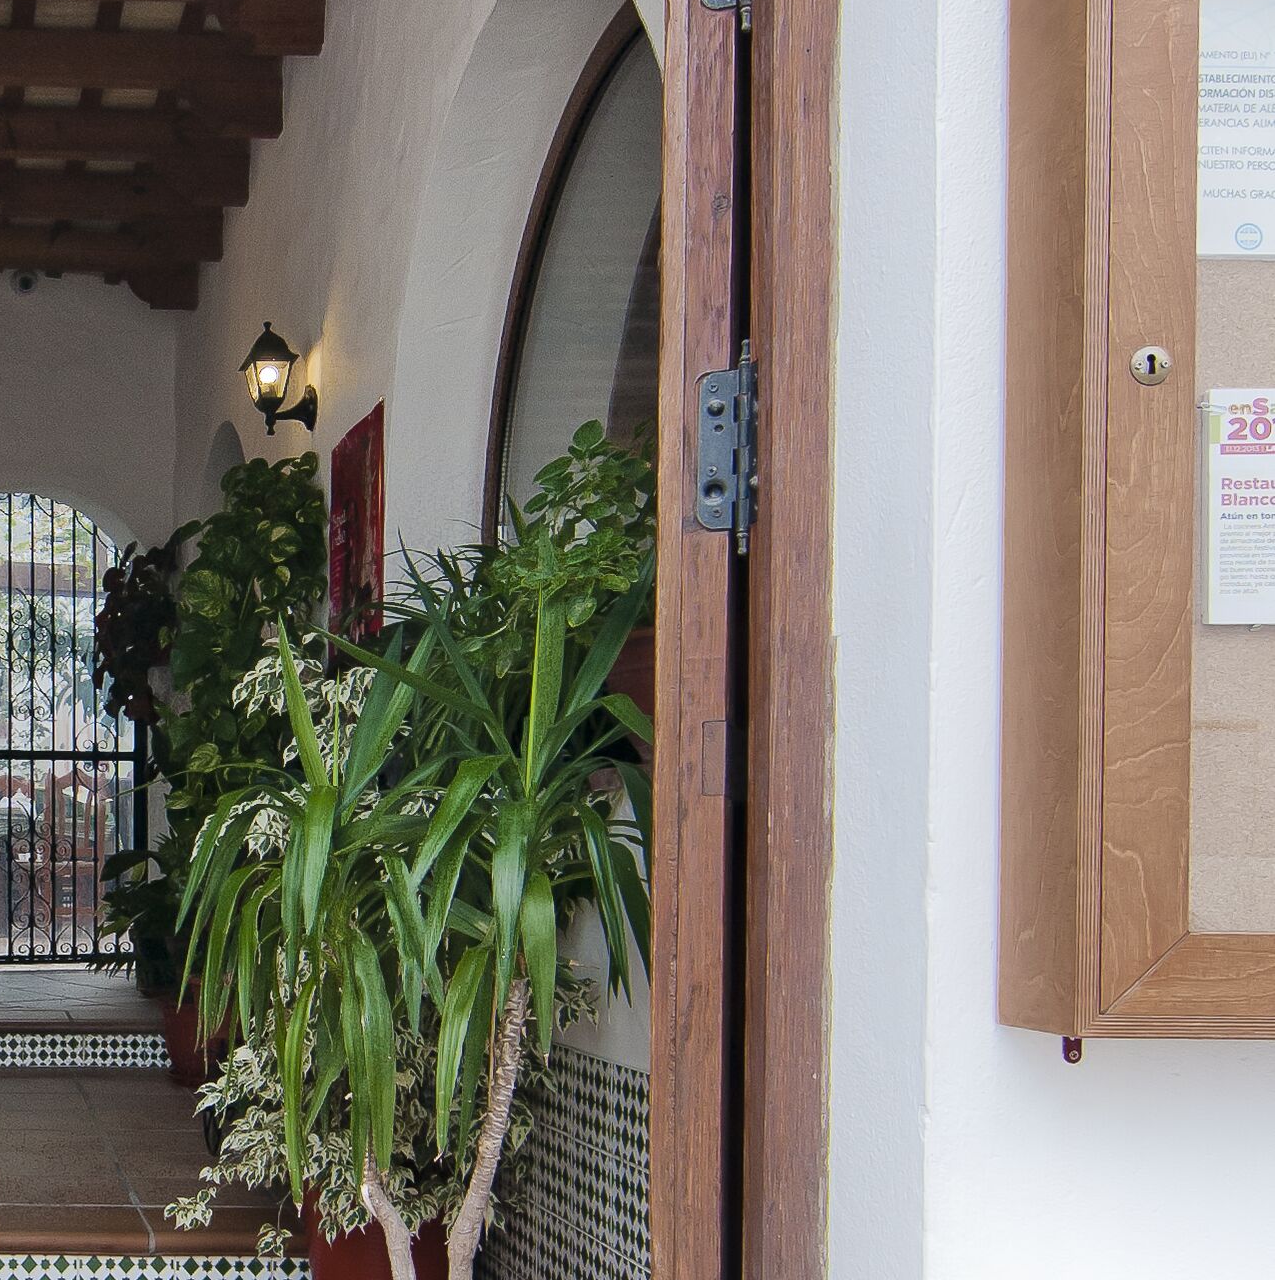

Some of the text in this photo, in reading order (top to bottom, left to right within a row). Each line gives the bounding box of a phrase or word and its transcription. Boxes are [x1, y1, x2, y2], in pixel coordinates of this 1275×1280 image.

[1241, 50, 1257, 61] (EU)
[1243, 104, 1256, 113] DE
[1199, 118, 1250, 128] ERANCIAS
[1231, 146, 1275, 156] INFORM
[1198, 160, 1244, 170] NUESTRO
[1203, 188, 1246, 199] MUCHAS
[1220, 512, 1243, 520] Atún
